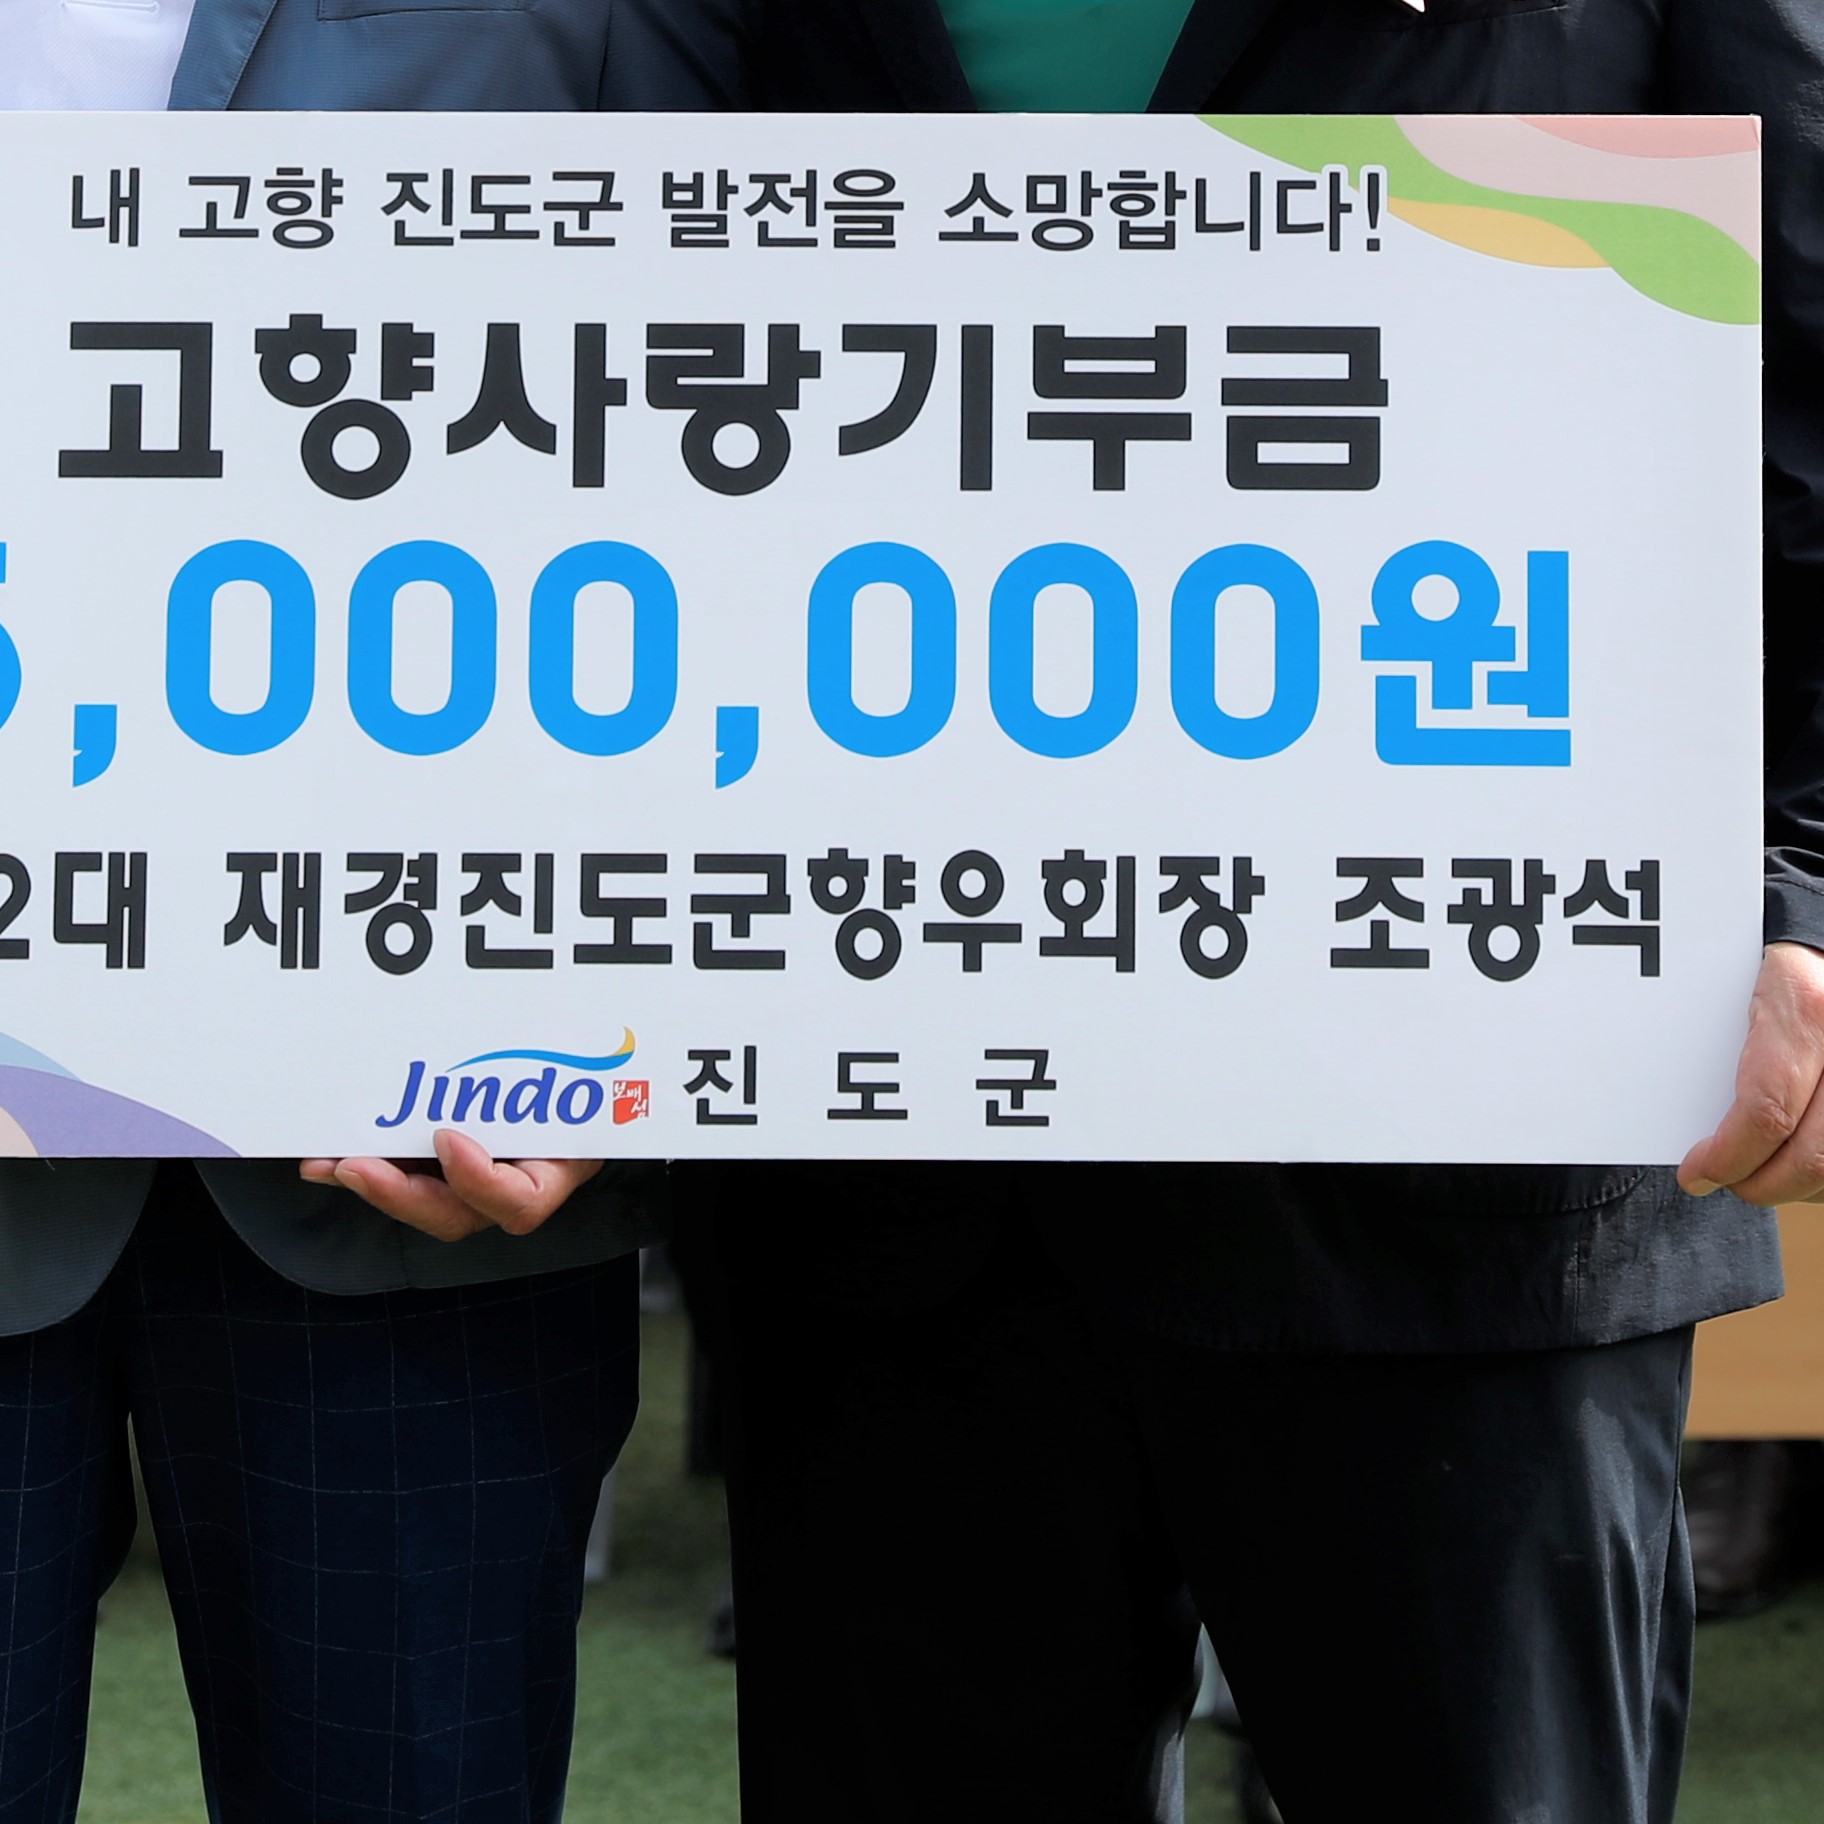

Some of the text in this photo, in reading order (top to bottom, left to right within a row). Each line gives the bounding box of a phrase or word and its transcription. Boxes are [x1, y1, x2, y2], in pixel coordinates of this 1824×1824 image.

[71, 167, 1382, 252] 내 고향 진도군 발전을 소망합니다!
[58, 313, 1389, 501] 고향사랑기부금
[223, 847, 1266, 981] 재경진도군향우회장
[1330, 857, 1661, 983] 조광석
[375, 1060, 604, 1128] Jindo
